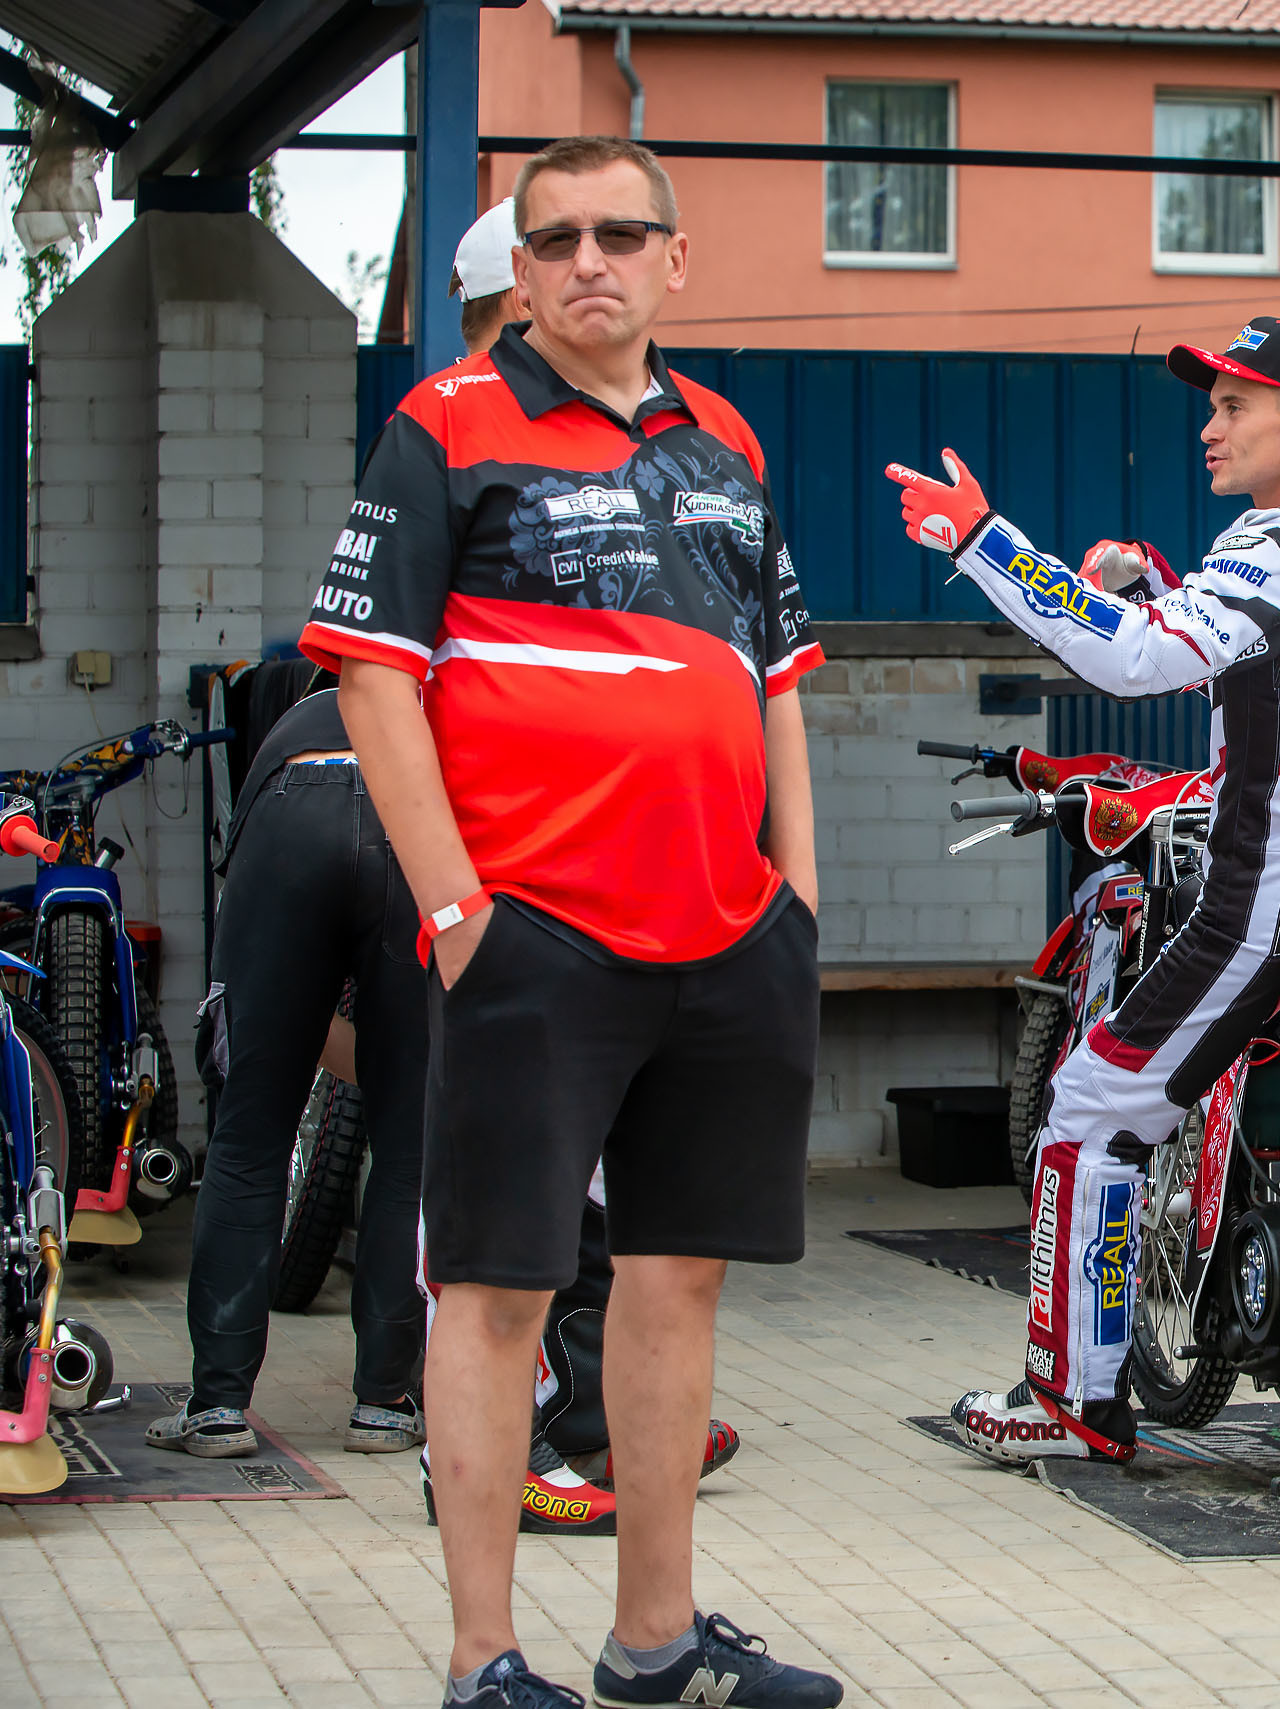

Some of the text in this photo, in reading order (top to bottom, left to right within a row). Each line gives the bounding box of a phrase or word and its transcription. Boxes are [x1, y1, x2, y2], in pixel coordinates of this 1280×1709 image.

[567, 494, 626, 512] REALL
[330, 560, 369, 581] DRINK
[557, 560, 578, 576] CVI
[1008, 553, 1093, 622] REALL
[1031, 1167, 1059, 1316] althimus
[1102, 1209, 1129, 1311] REALL
[966, 1409, 1068, 1444] daytona
[680, 1668, 740, 1709] N
